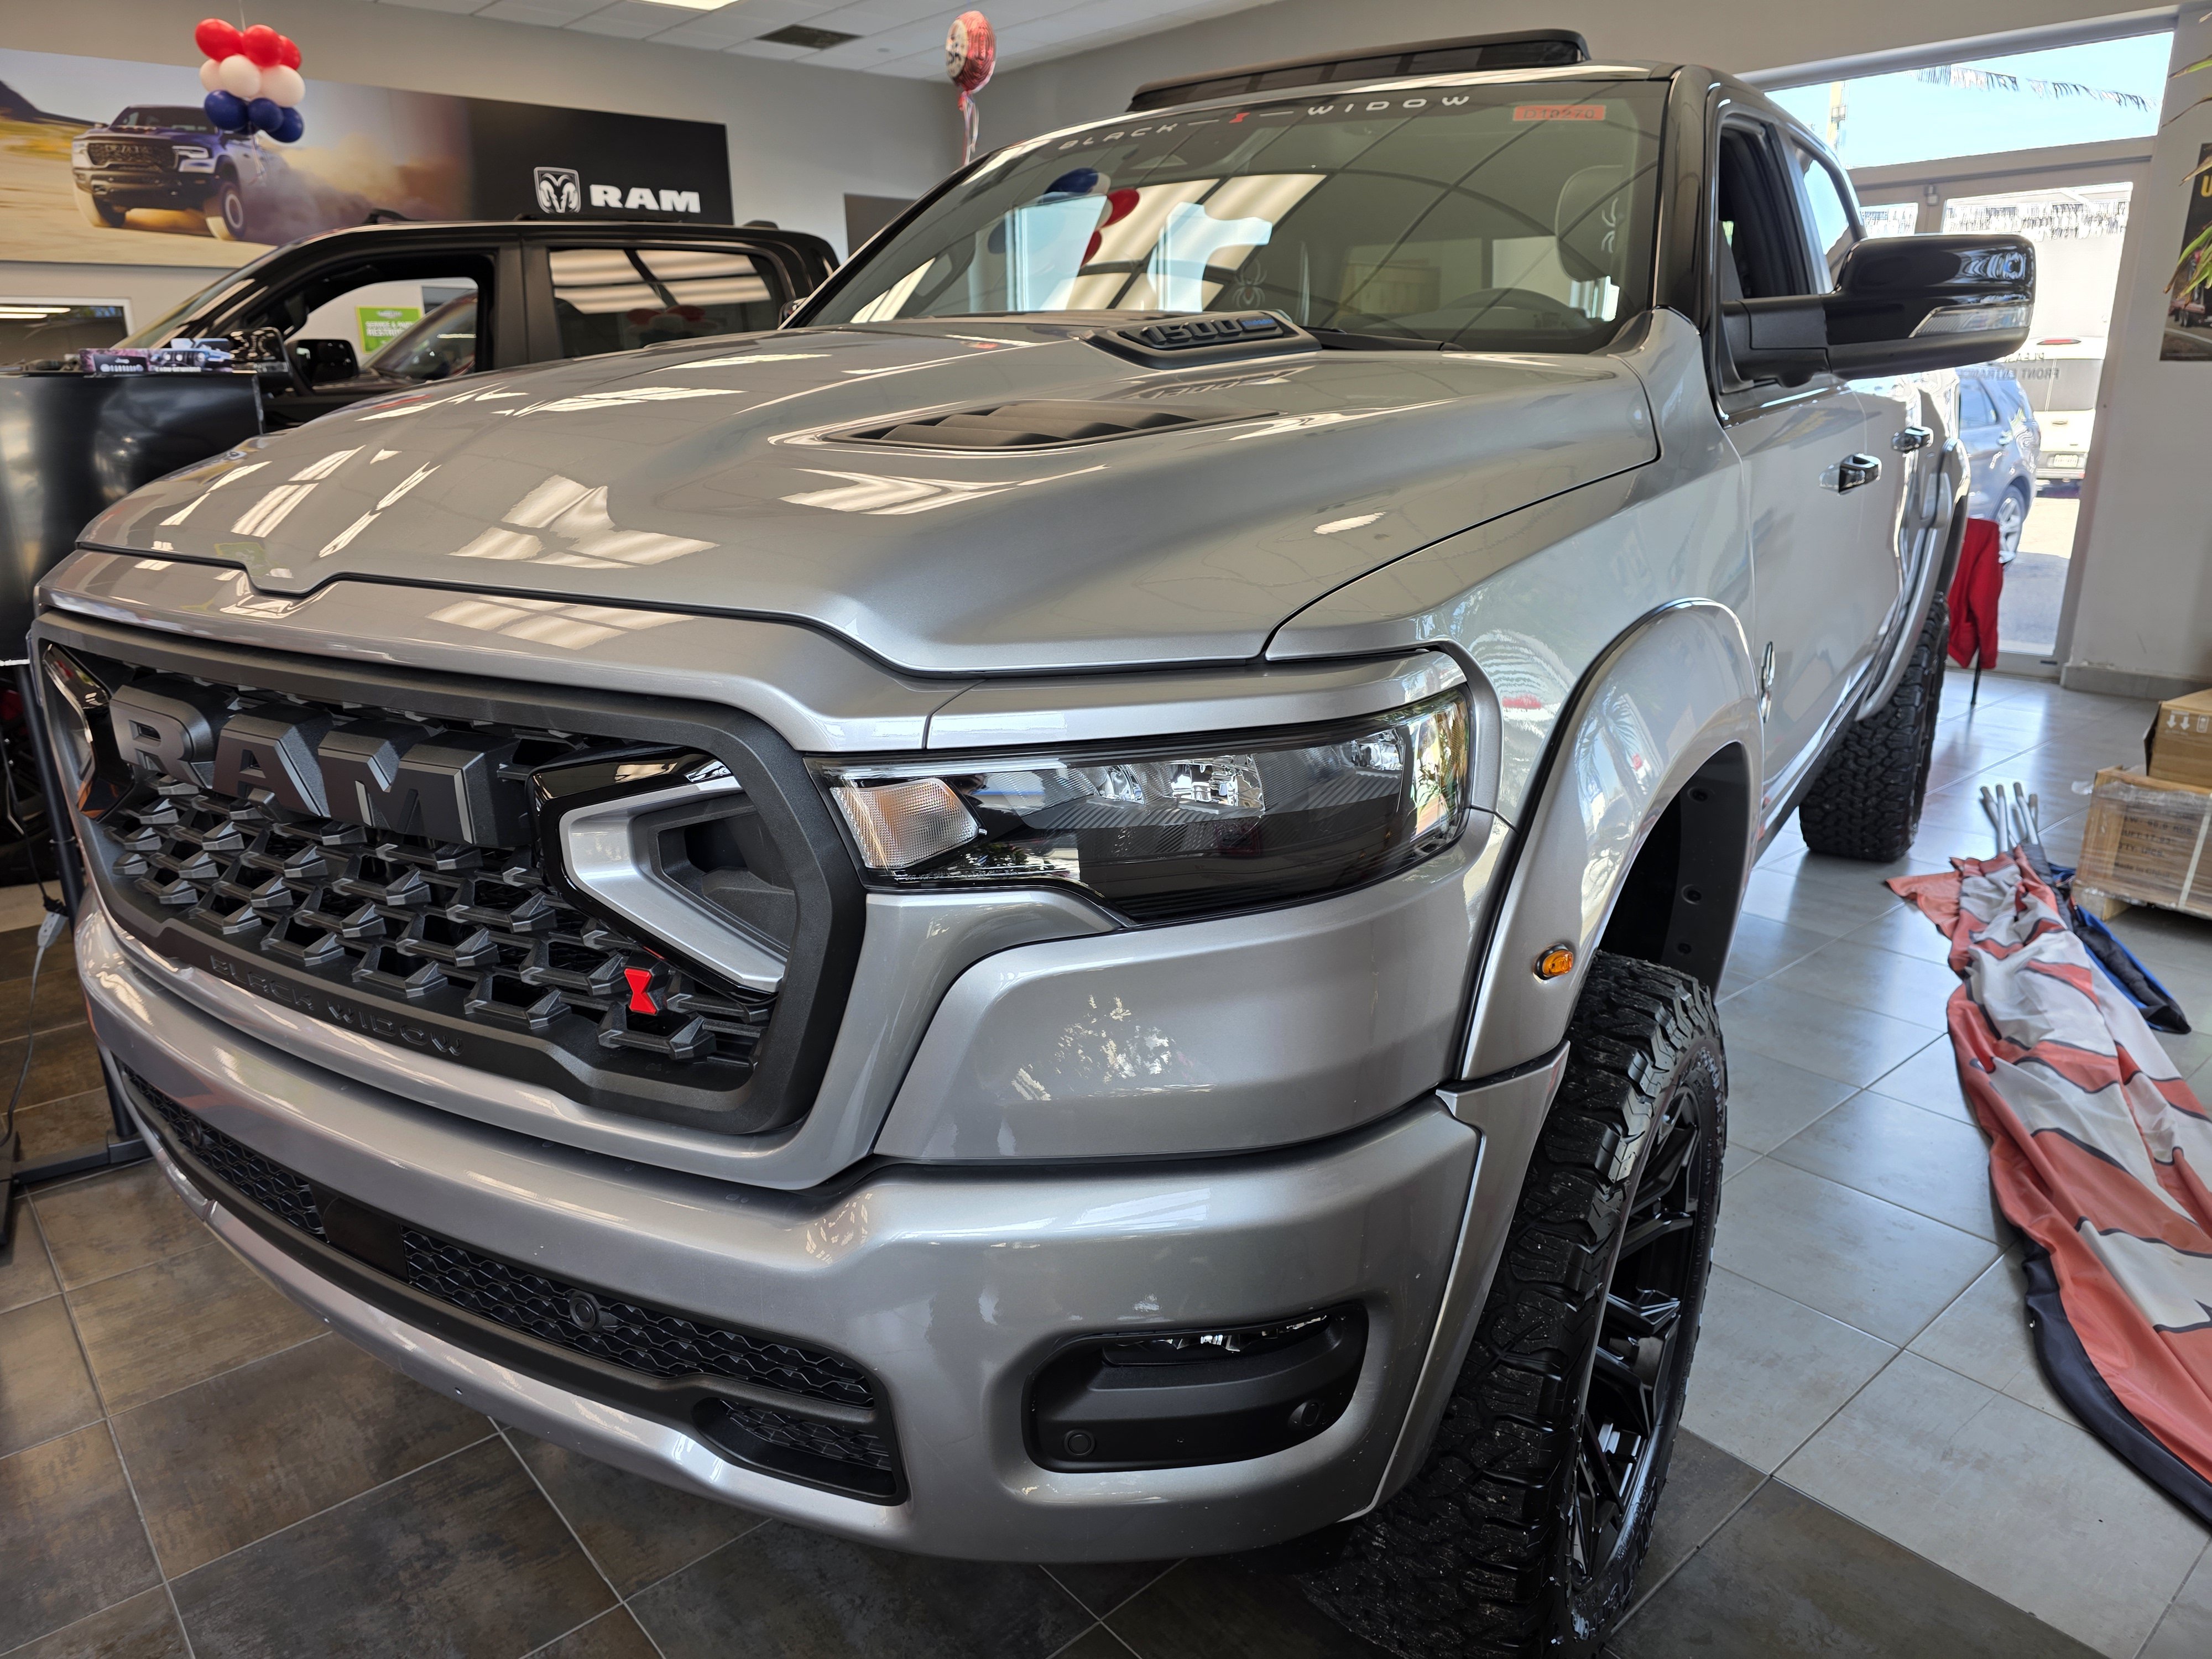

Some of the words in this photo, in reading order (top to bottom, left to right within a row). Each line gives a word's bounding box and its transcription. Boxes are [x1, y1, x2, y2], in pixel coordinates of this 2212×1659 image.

[1058, 123, 1178, 150] BLACK
[1308, 96, 1470, 116] WIDOW
[589, 184, 701, 213] RAM
[1140, 319, 1242, 345] 1500
[109, 676, 492, 846] RAM
[210, 955, 314, 1010] BLACK
[327, 1000, 466, 1056] WIDOW
